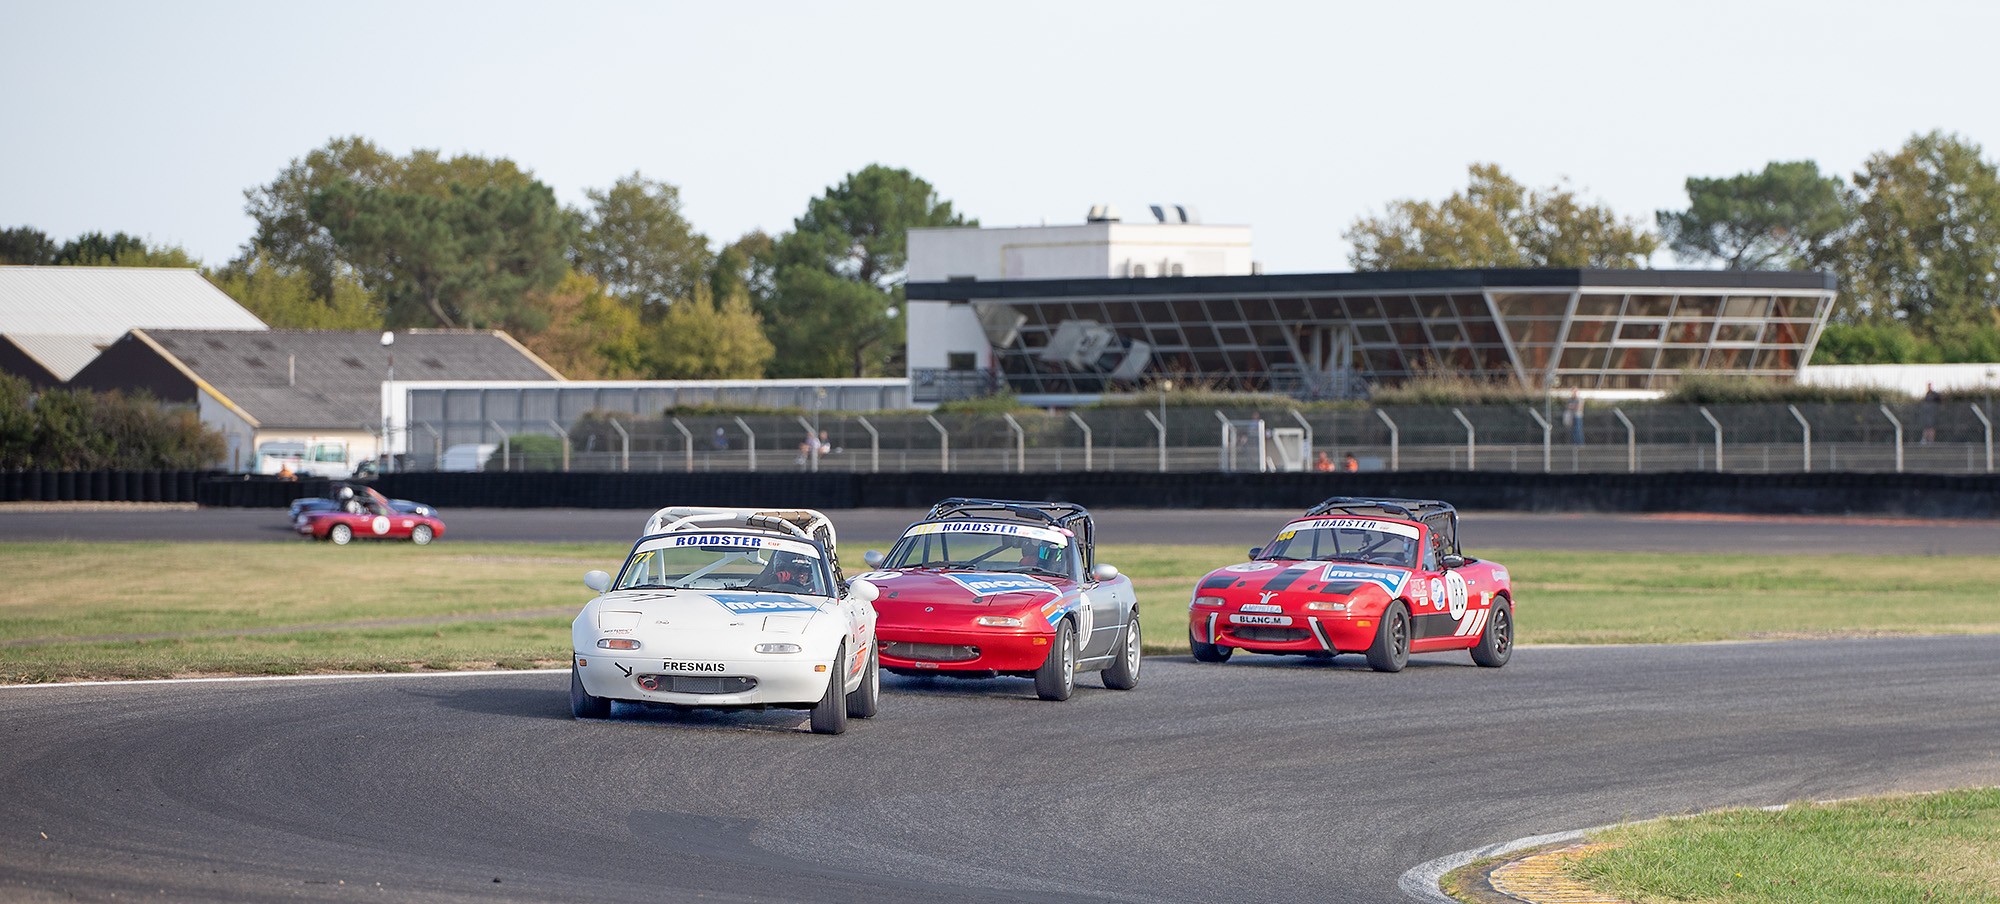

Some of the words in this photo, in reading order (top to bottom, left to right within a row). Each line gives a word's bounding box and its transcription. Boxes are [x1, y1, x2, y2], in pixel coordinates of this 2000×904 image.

[942, 523, 1018, 534] ROADSTER
[1312, 519, 1377, 529] ROADSTER
[675, 535, 762, 547] ROADSTER
[634, 551, 656, 564] 77
[663, 661, 725, 672] FRESNAIS
